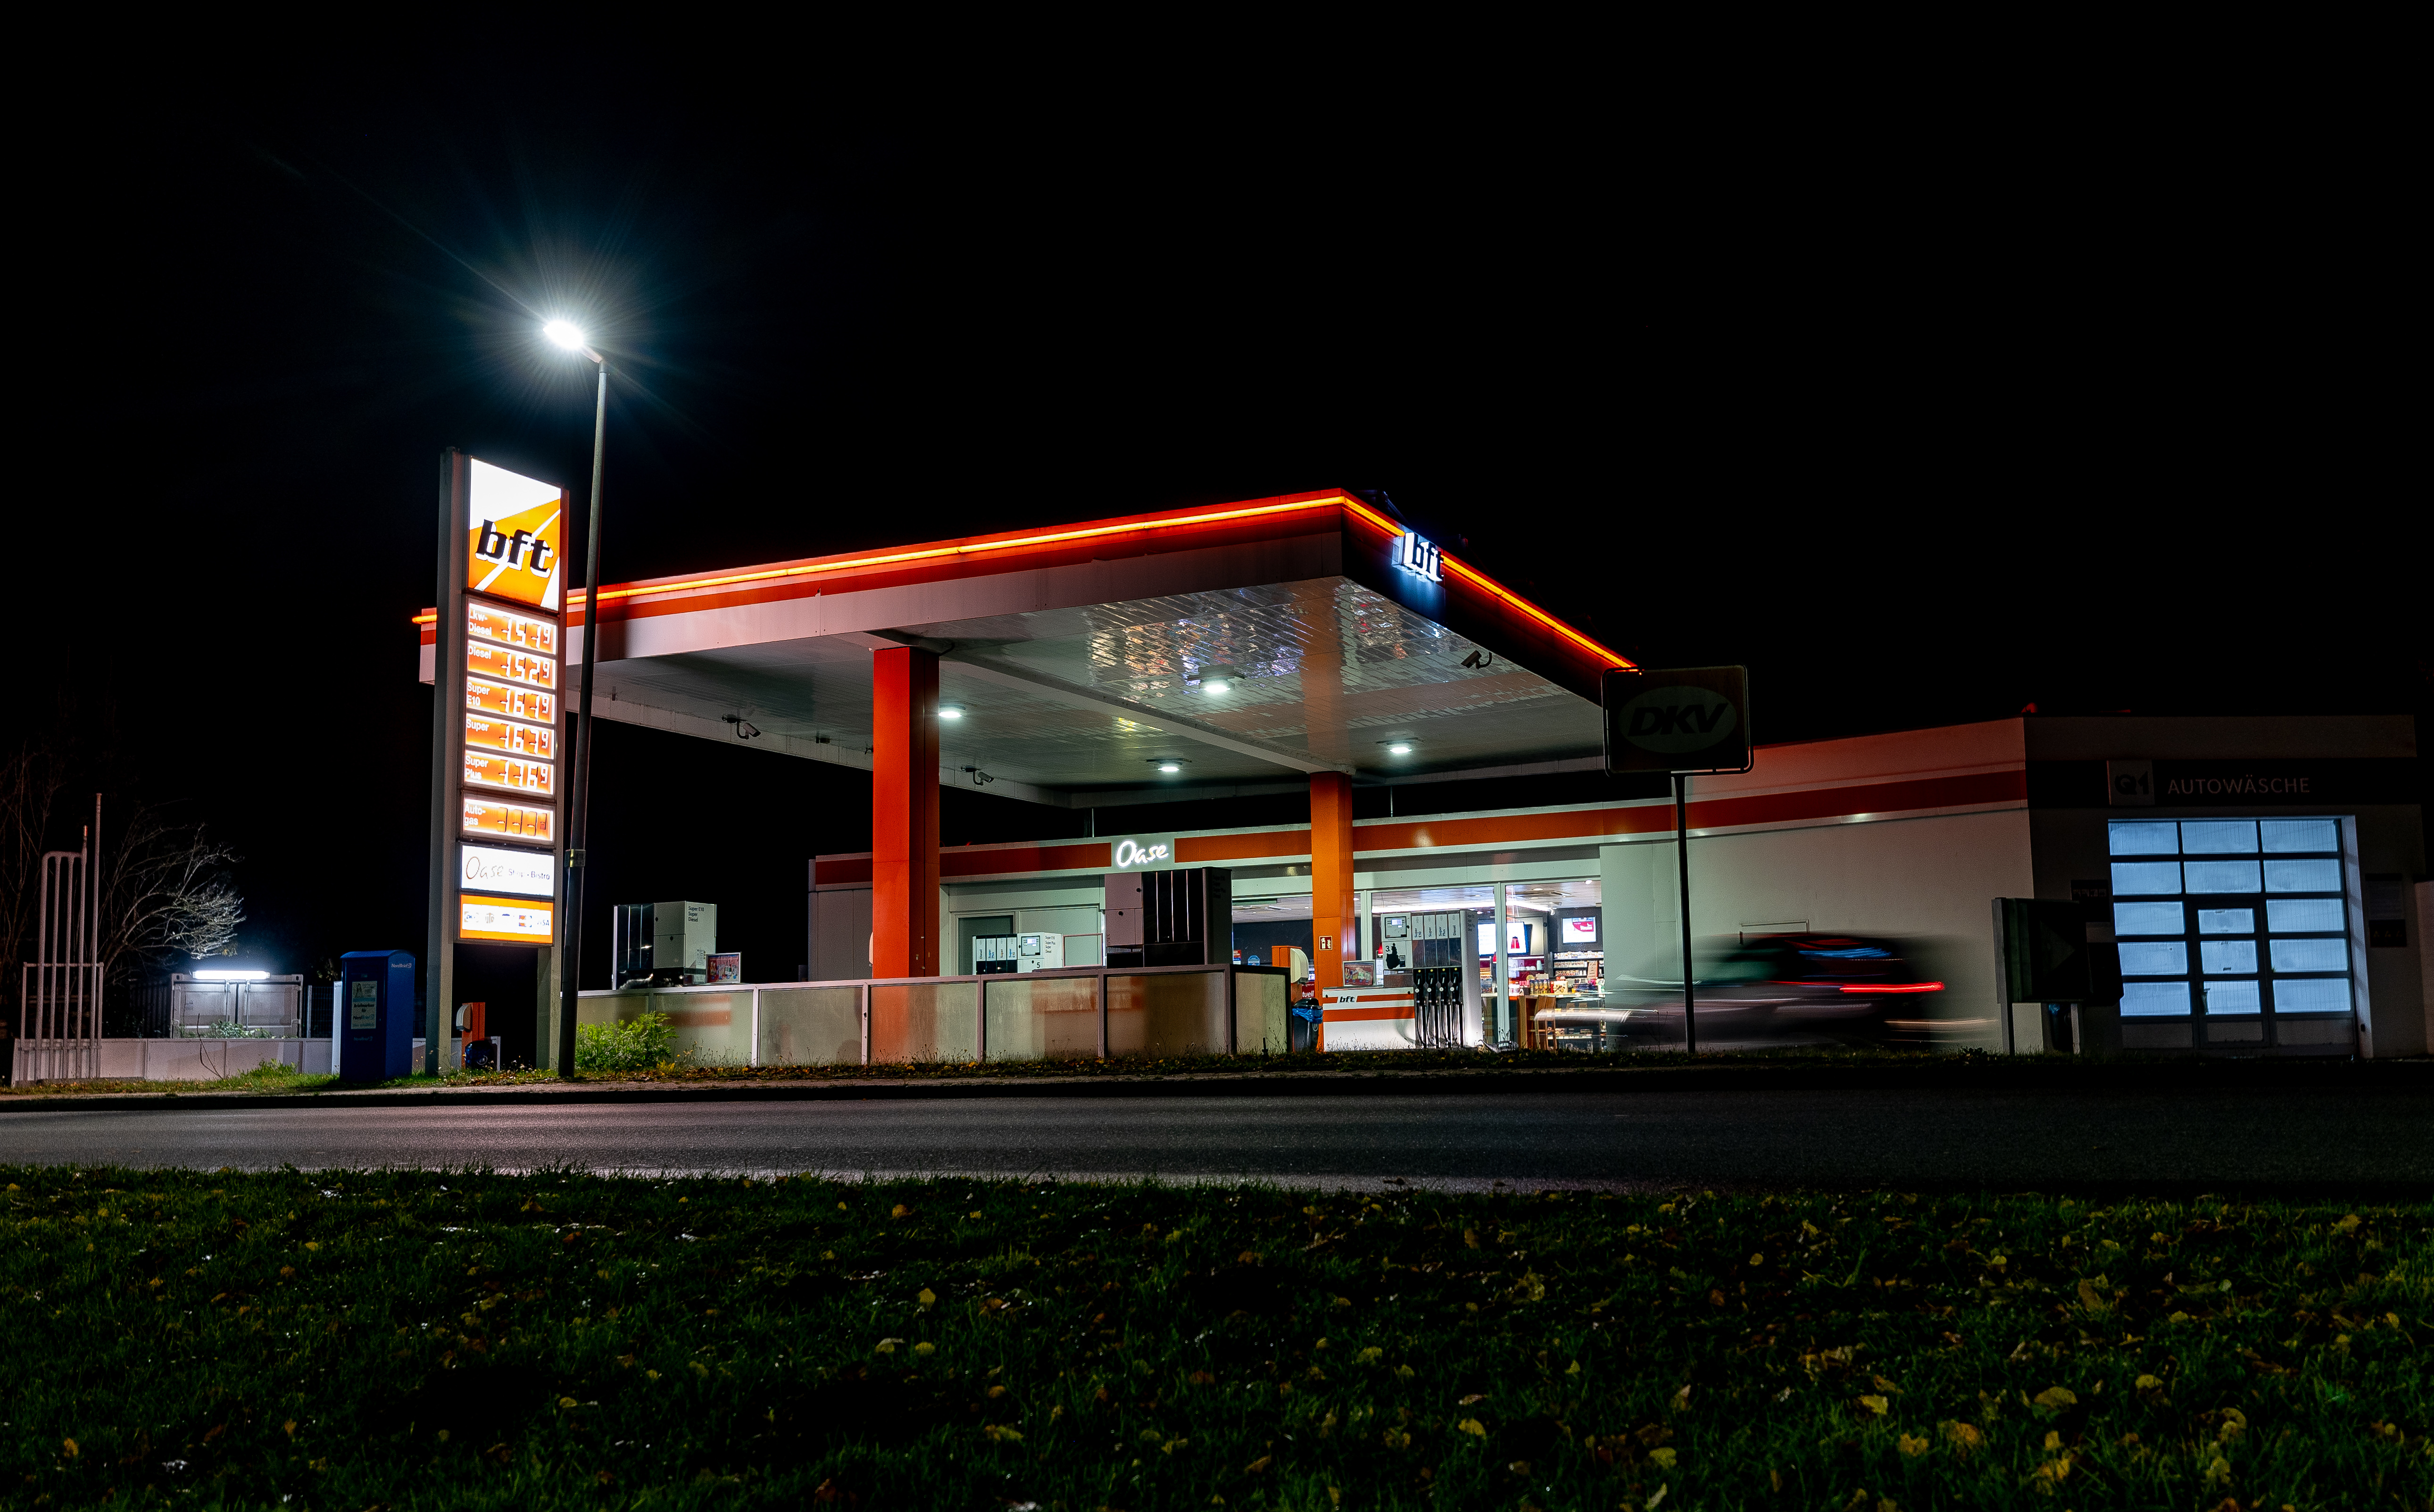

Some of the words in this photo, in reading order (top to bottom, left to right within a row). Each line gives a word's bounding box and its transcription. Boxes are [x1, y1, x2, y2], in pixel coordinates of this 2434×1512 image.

[475, 519, 552, 573] bft
[1408, 532, 1445, 582] bft
[468, 622, 492, 636] Diesel
[468, 645, 491, 659] Diesel
[467, 681, 490, 695] Super
[467, 695, 481, 706] E10
[466, 718, 490, 731] Super
[1628, 703, 1728, 737] DKV
[465, 755, 489, 768] Super
[465, 768, 482, 780] Plus
[2115, 771, 2149, 795] Q1
[2168, 774, 2310, 795] AUTOWÄSCHE
[465, 803, 486, 815] Auto-
[464, 817, 479, 826] gas
[1116, 840, 1169, 867] Oase
[466, 856, 503, 880] Oase
[531, 871, 550, 880] Bistro
